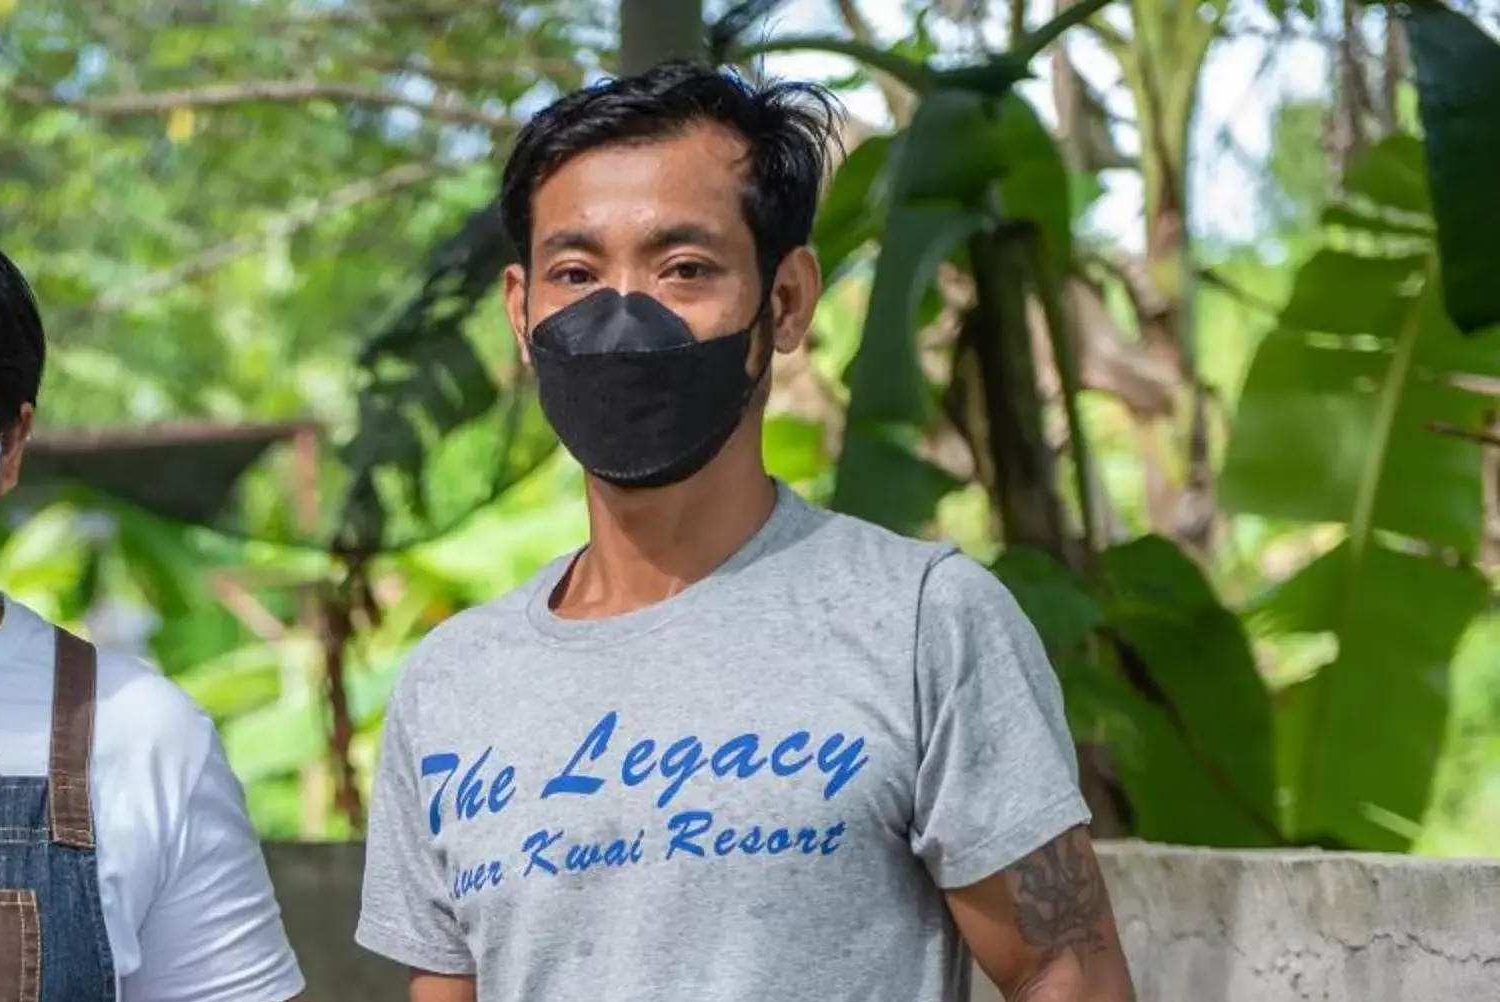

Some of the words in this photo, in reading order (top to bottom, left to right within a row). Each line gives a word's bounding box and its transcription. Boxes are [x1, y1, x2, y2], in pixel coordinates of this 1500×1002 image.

[420, 745, 517, 836] The
[539, 710, 870, 810] Legacy
[521, 828, 645, 878] Kwai
[664, 808, 848, 862] Resort
